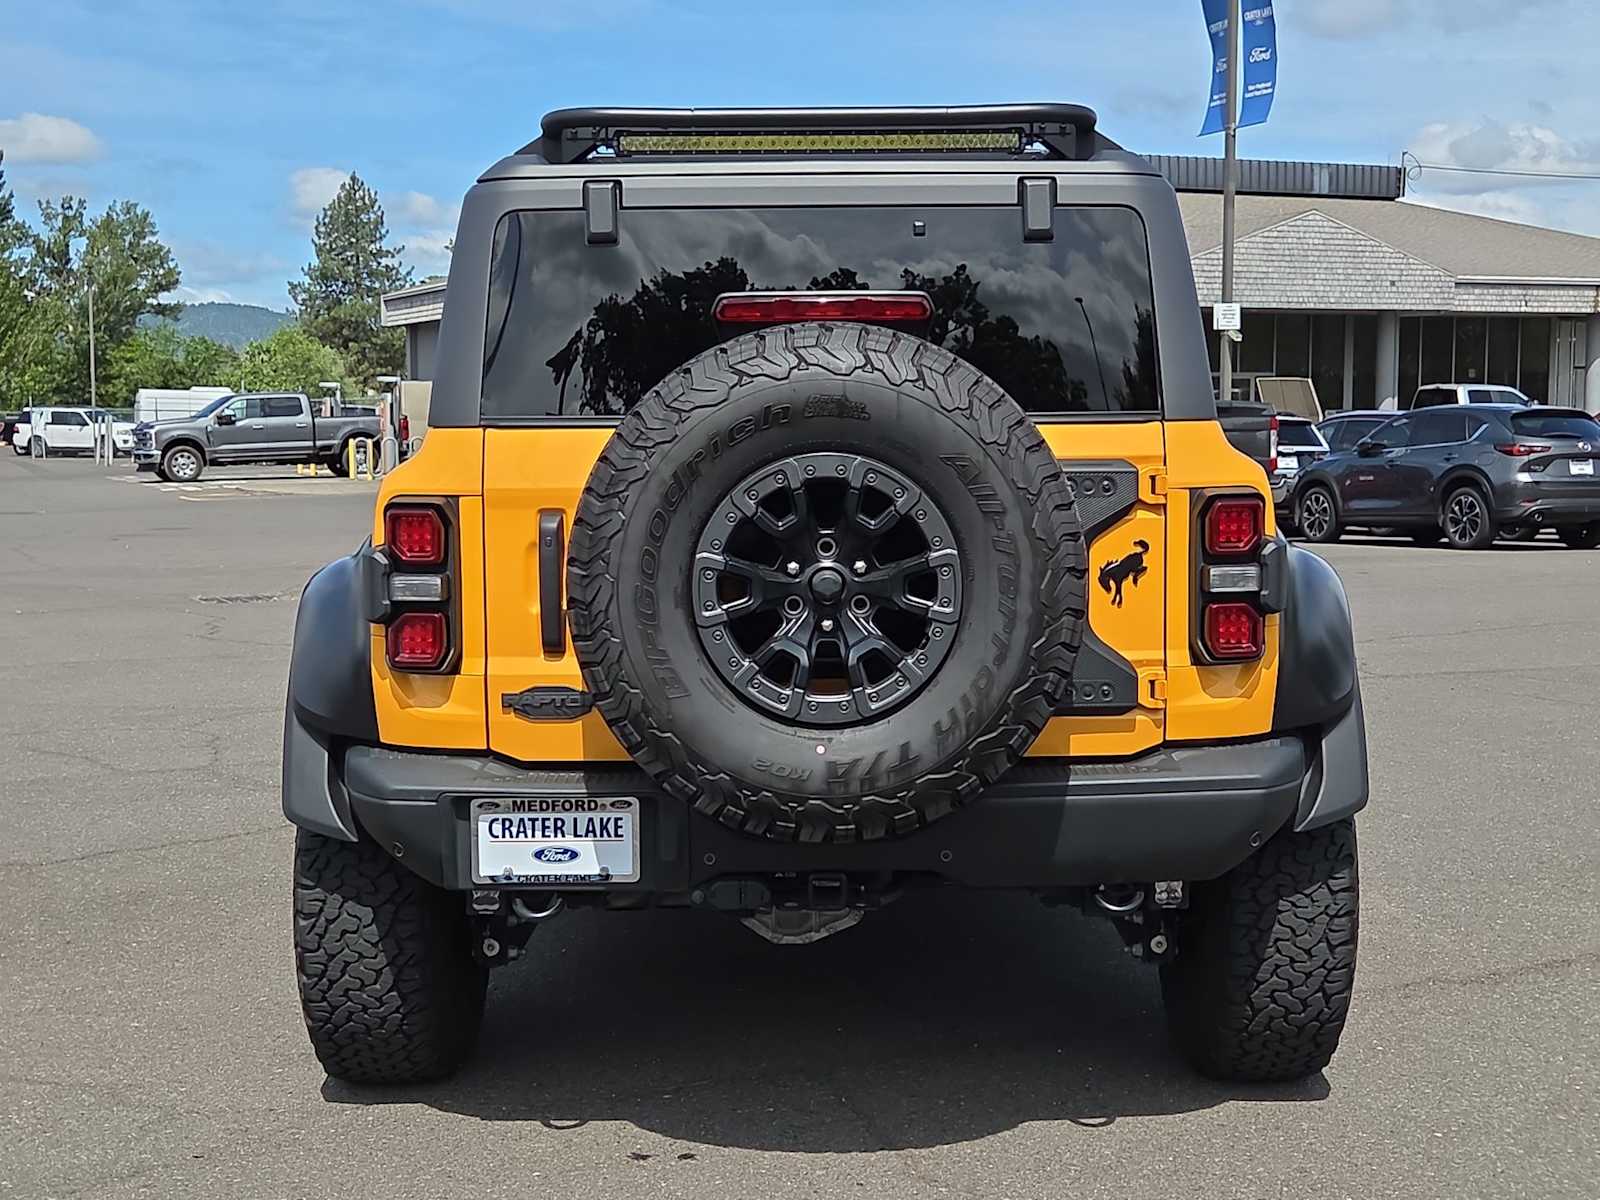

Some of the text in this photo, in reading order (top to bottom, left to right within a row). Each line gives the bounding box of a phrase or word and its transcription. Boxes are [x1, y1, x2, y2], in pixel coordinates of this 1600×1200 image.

[1249, 47, 1272, 63] Ford
[633, 401, 793, 700] BFGoodrich
[502, 693, 595, 707] RAPTO
[751, 758, 814, 782] KO2
[511, 799, 599, 812] MEDFORD
[488, 817, 624, 839] CRATER LAKE
[540, 847, 572, 861] Ford
